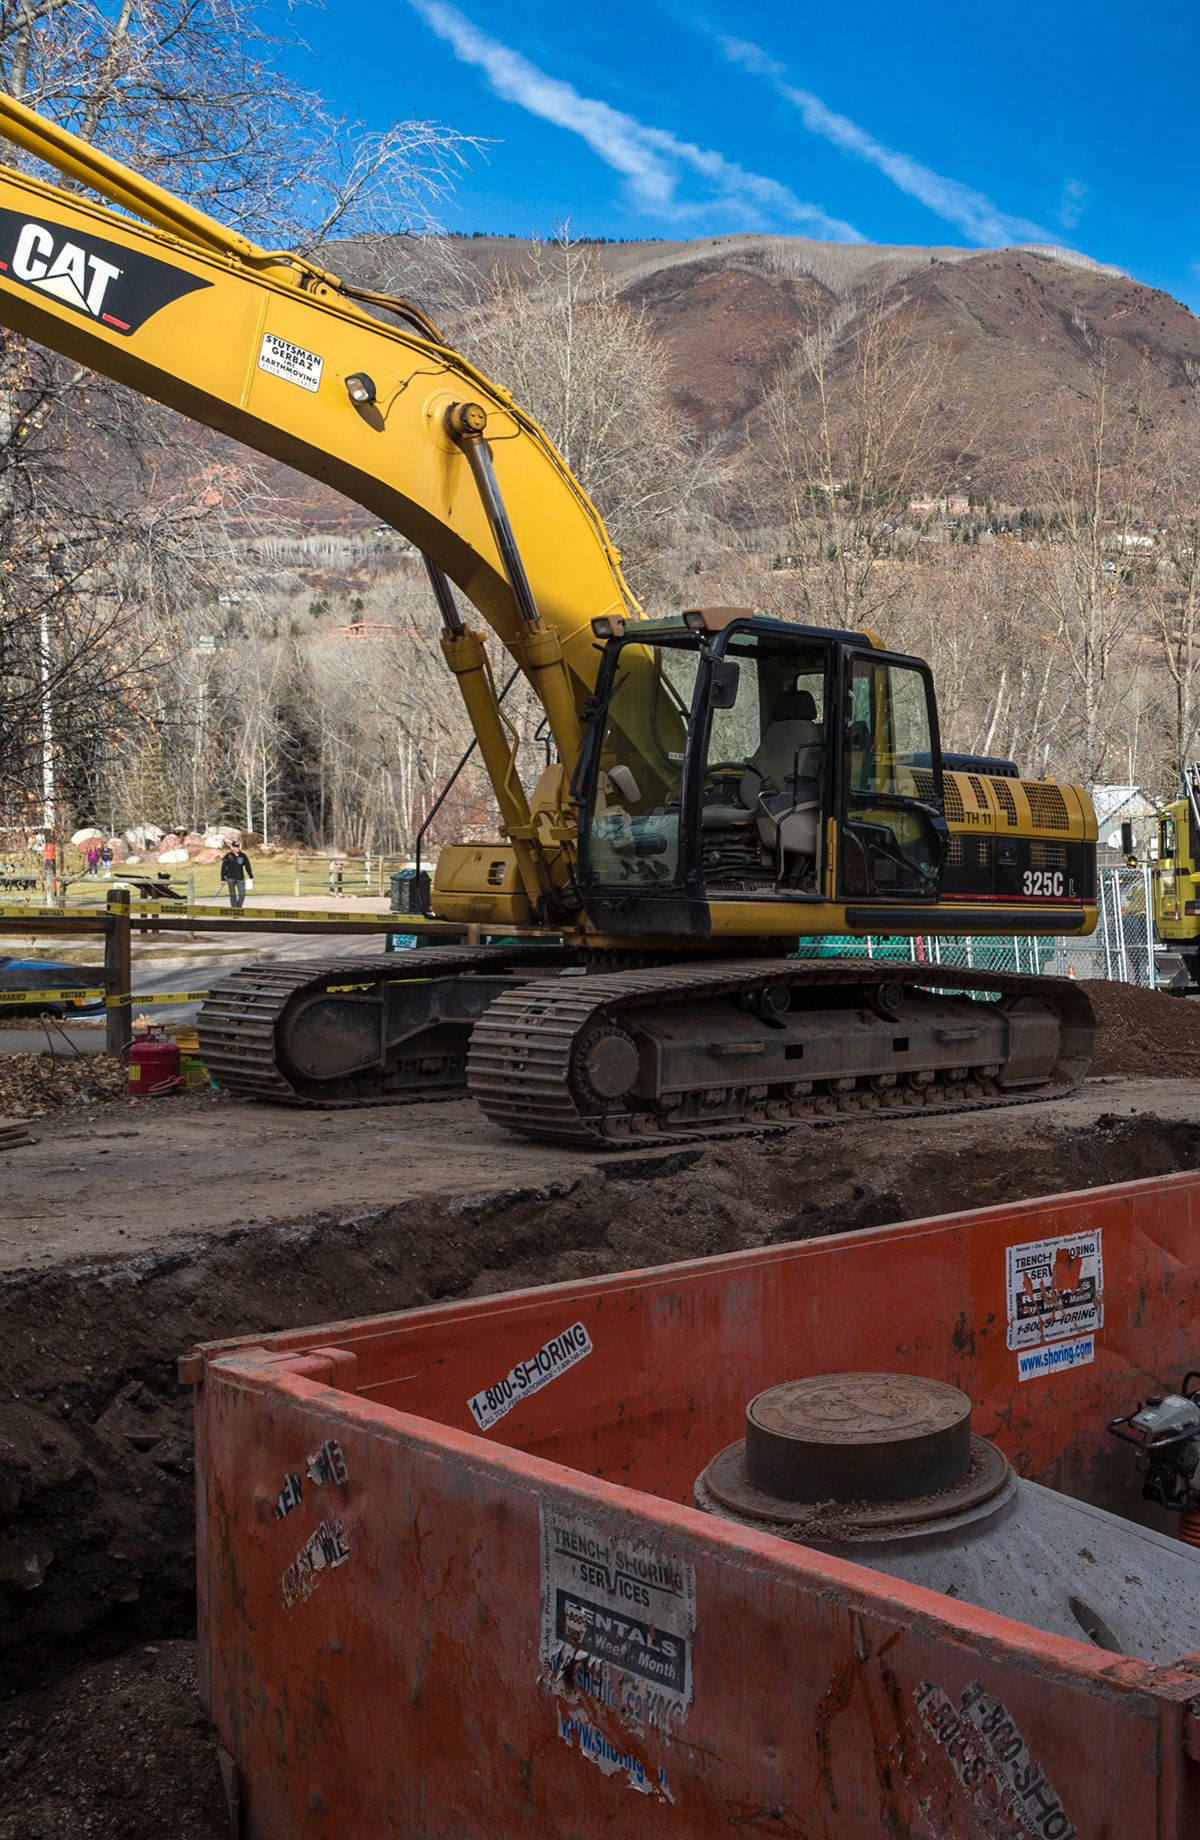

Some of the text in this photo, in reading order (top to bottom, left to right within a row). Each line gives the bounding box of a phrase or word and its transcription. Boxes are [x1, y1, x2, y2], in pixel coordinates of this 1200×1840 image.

[12, 223, 120, 316] CAT
[266, 335, 321, 365] STUTSMAN
[272, 346, 313, 370] GERBAZ
[261, 355, 318, 384] EARTHMOVING
[966, 812, 991, 824] TH 11
[1023, 871, 1077, 897] 325C L
[1015, 1252, 1052, 1268] TRENCH
[1070, 1292, 1091, 1304] Month
[1021, 1341, 1092, 1372] www.shoring.com
[472, 1324, 587, 1420] 1-800-SHORING
[553, 1527, 608, 1563] TRENCH
[615, 1551, 684, 1592] SHORING
[580, 1564, 650, 1607] SERVICES
[566, 1601, 678, 1658] ENTALS
[639, 1652, 676, 1679] Month
